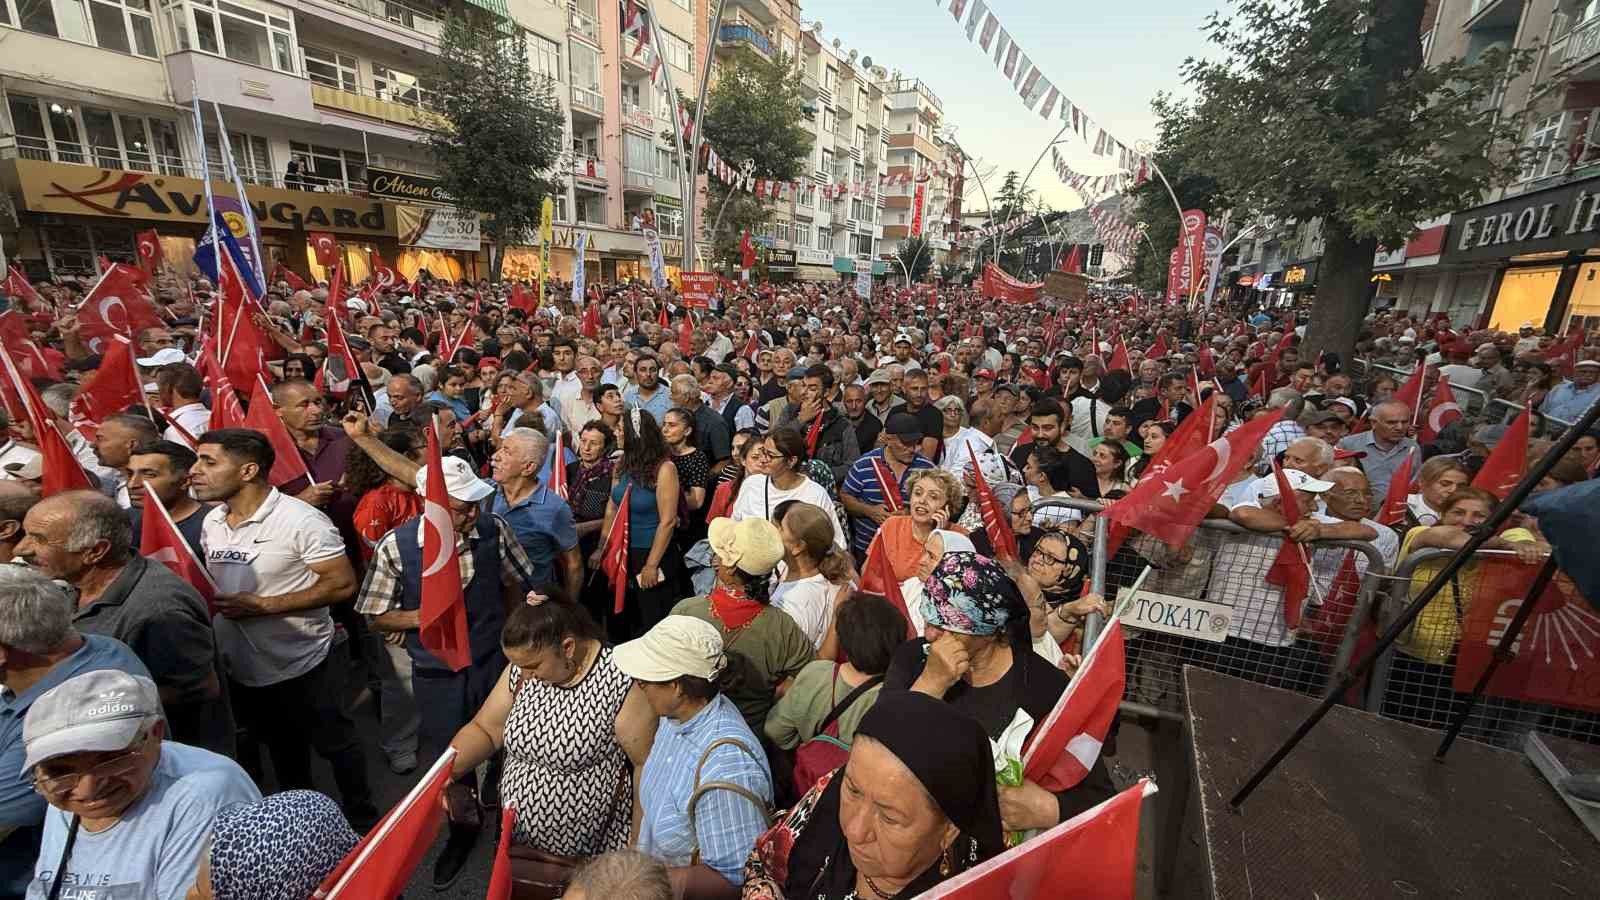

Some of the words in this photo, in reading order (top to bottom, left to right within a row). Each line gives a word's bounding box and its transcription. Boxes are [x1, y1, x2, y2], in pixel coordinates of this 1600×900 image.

[1477, 203, 1557, 247] EROL
[1136, 598, 1210, 632] TOKAT
[88, 703, 136, 716] adidas
